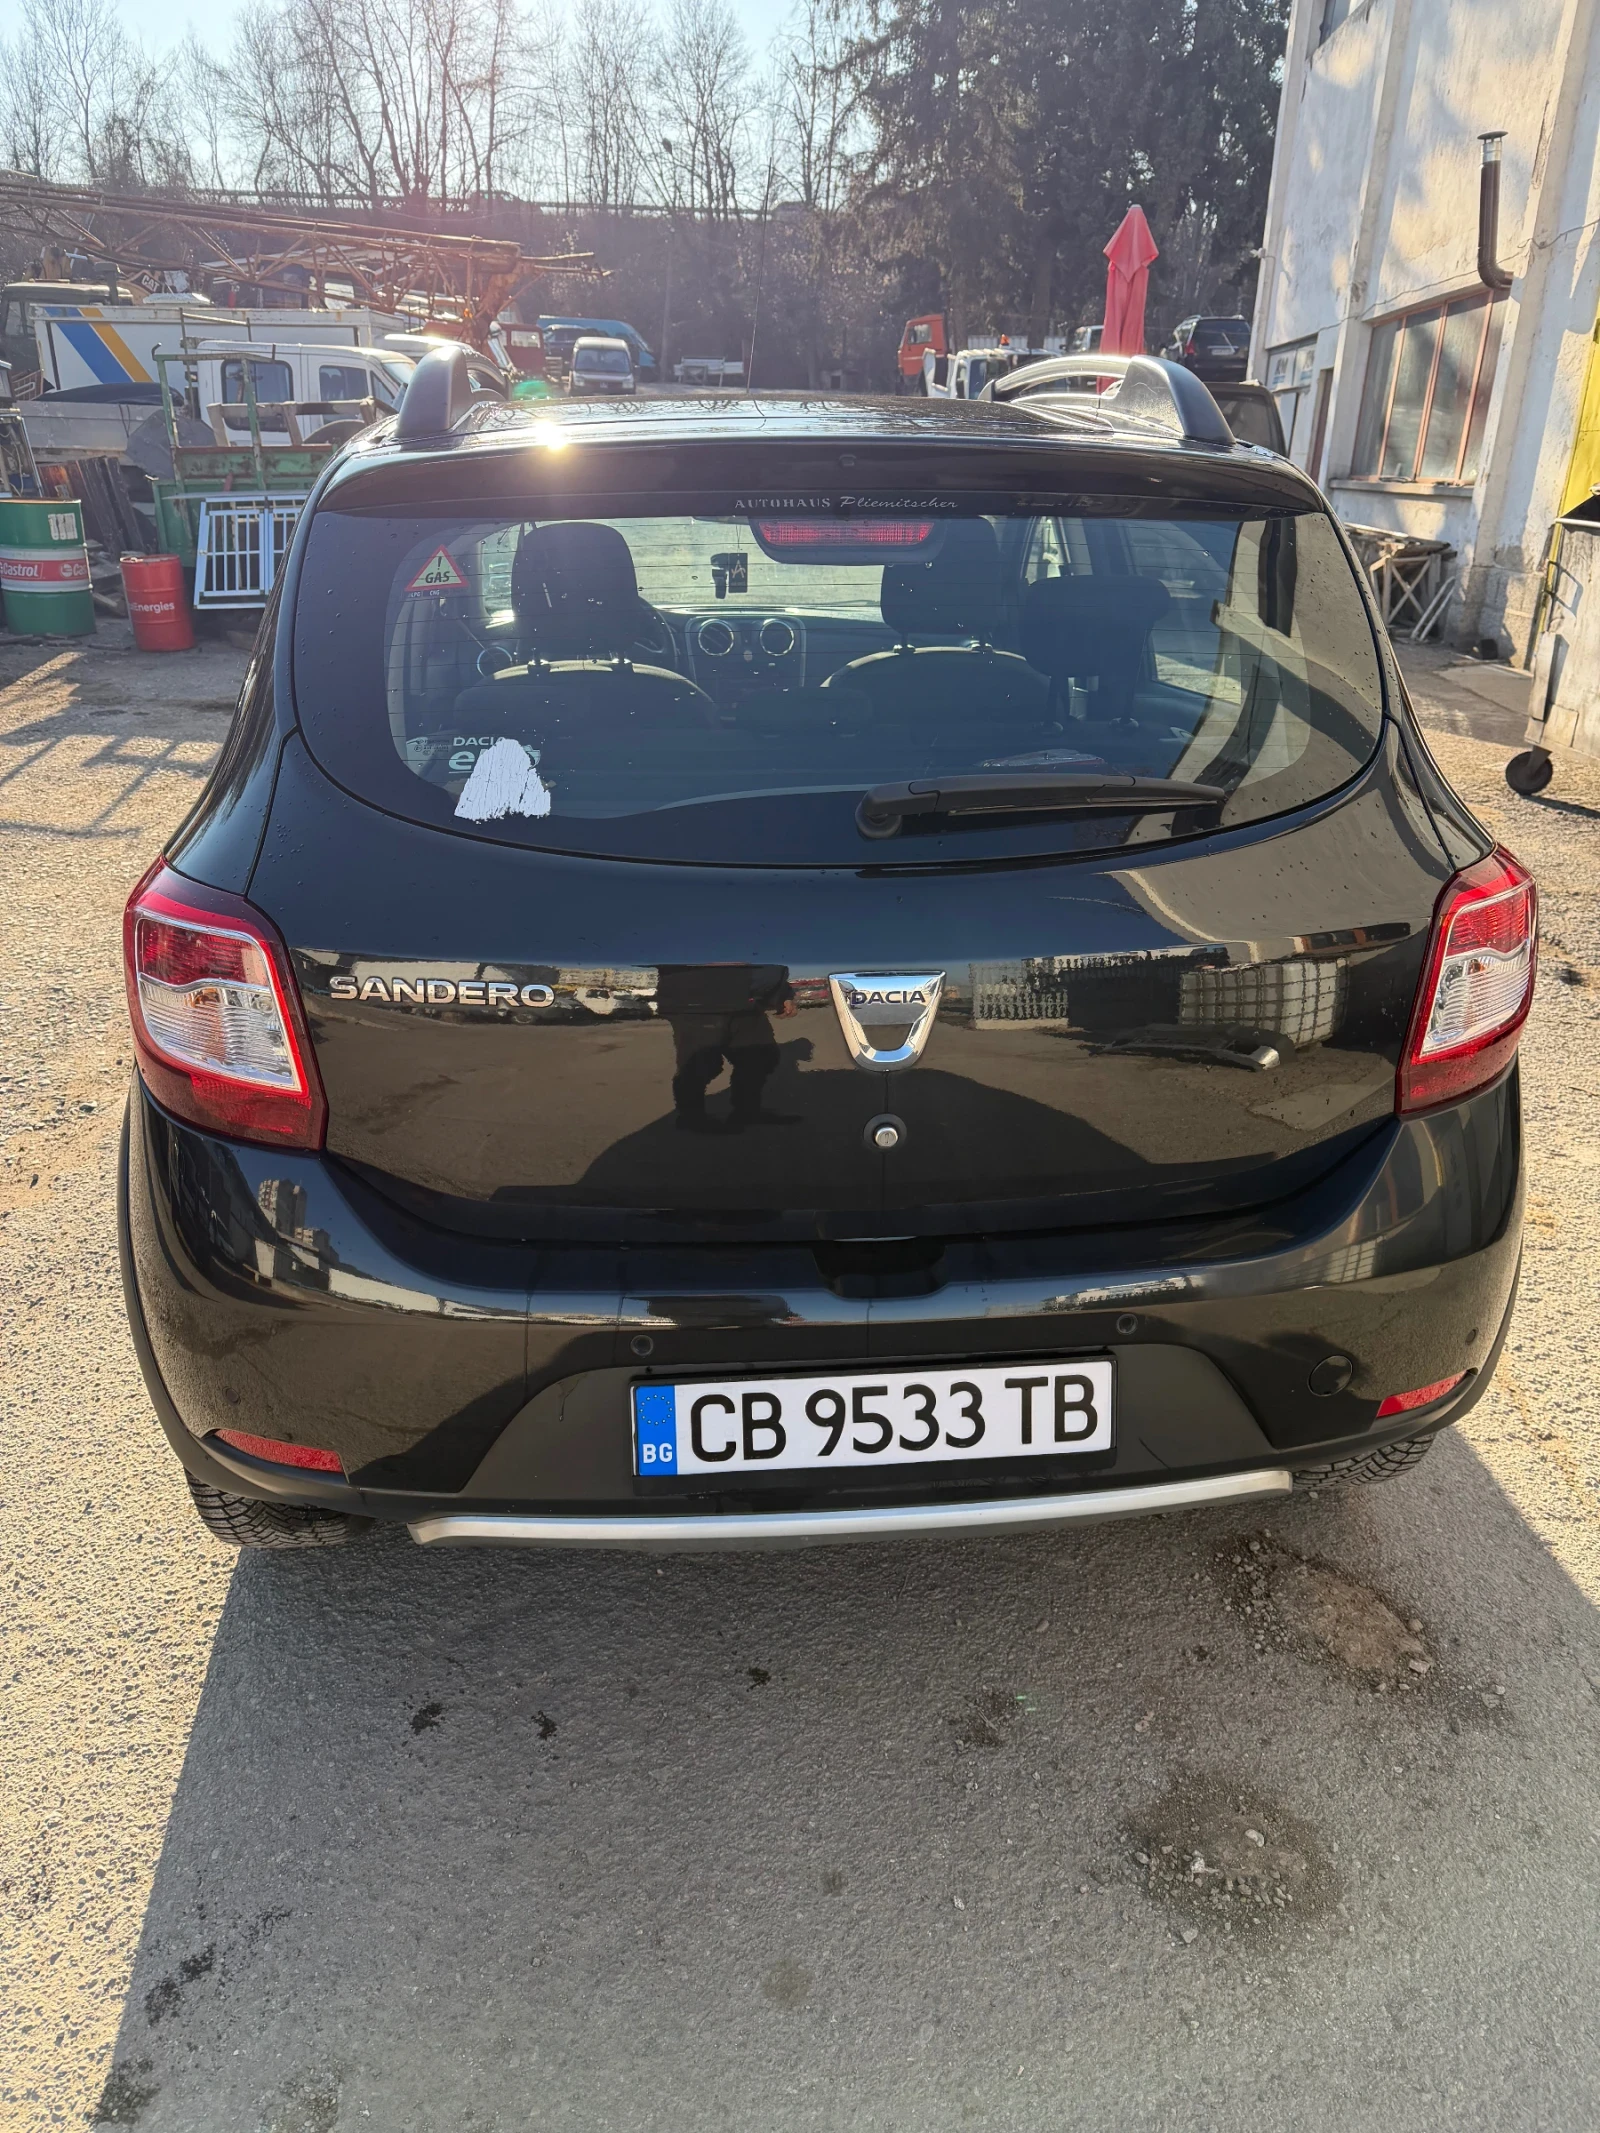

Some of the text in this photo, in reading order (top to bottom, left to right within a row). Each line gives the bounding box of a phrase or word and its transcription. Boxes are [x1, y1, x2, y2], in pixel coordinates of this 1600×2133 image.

[141, 274, 160, 292] CAT
[734, 497, 831, 509] AUTOHAUS
[3, 562, 39, 577] Castrol
[425, 571, 450, 584] GAS
[329, 976, 556, 1008] SANDERO
[850, 990, 926, 1005] DACIA
[689, 1373, 1099, 1462] CB 9533 TB
[643, 1443, 673, 1463] BG
